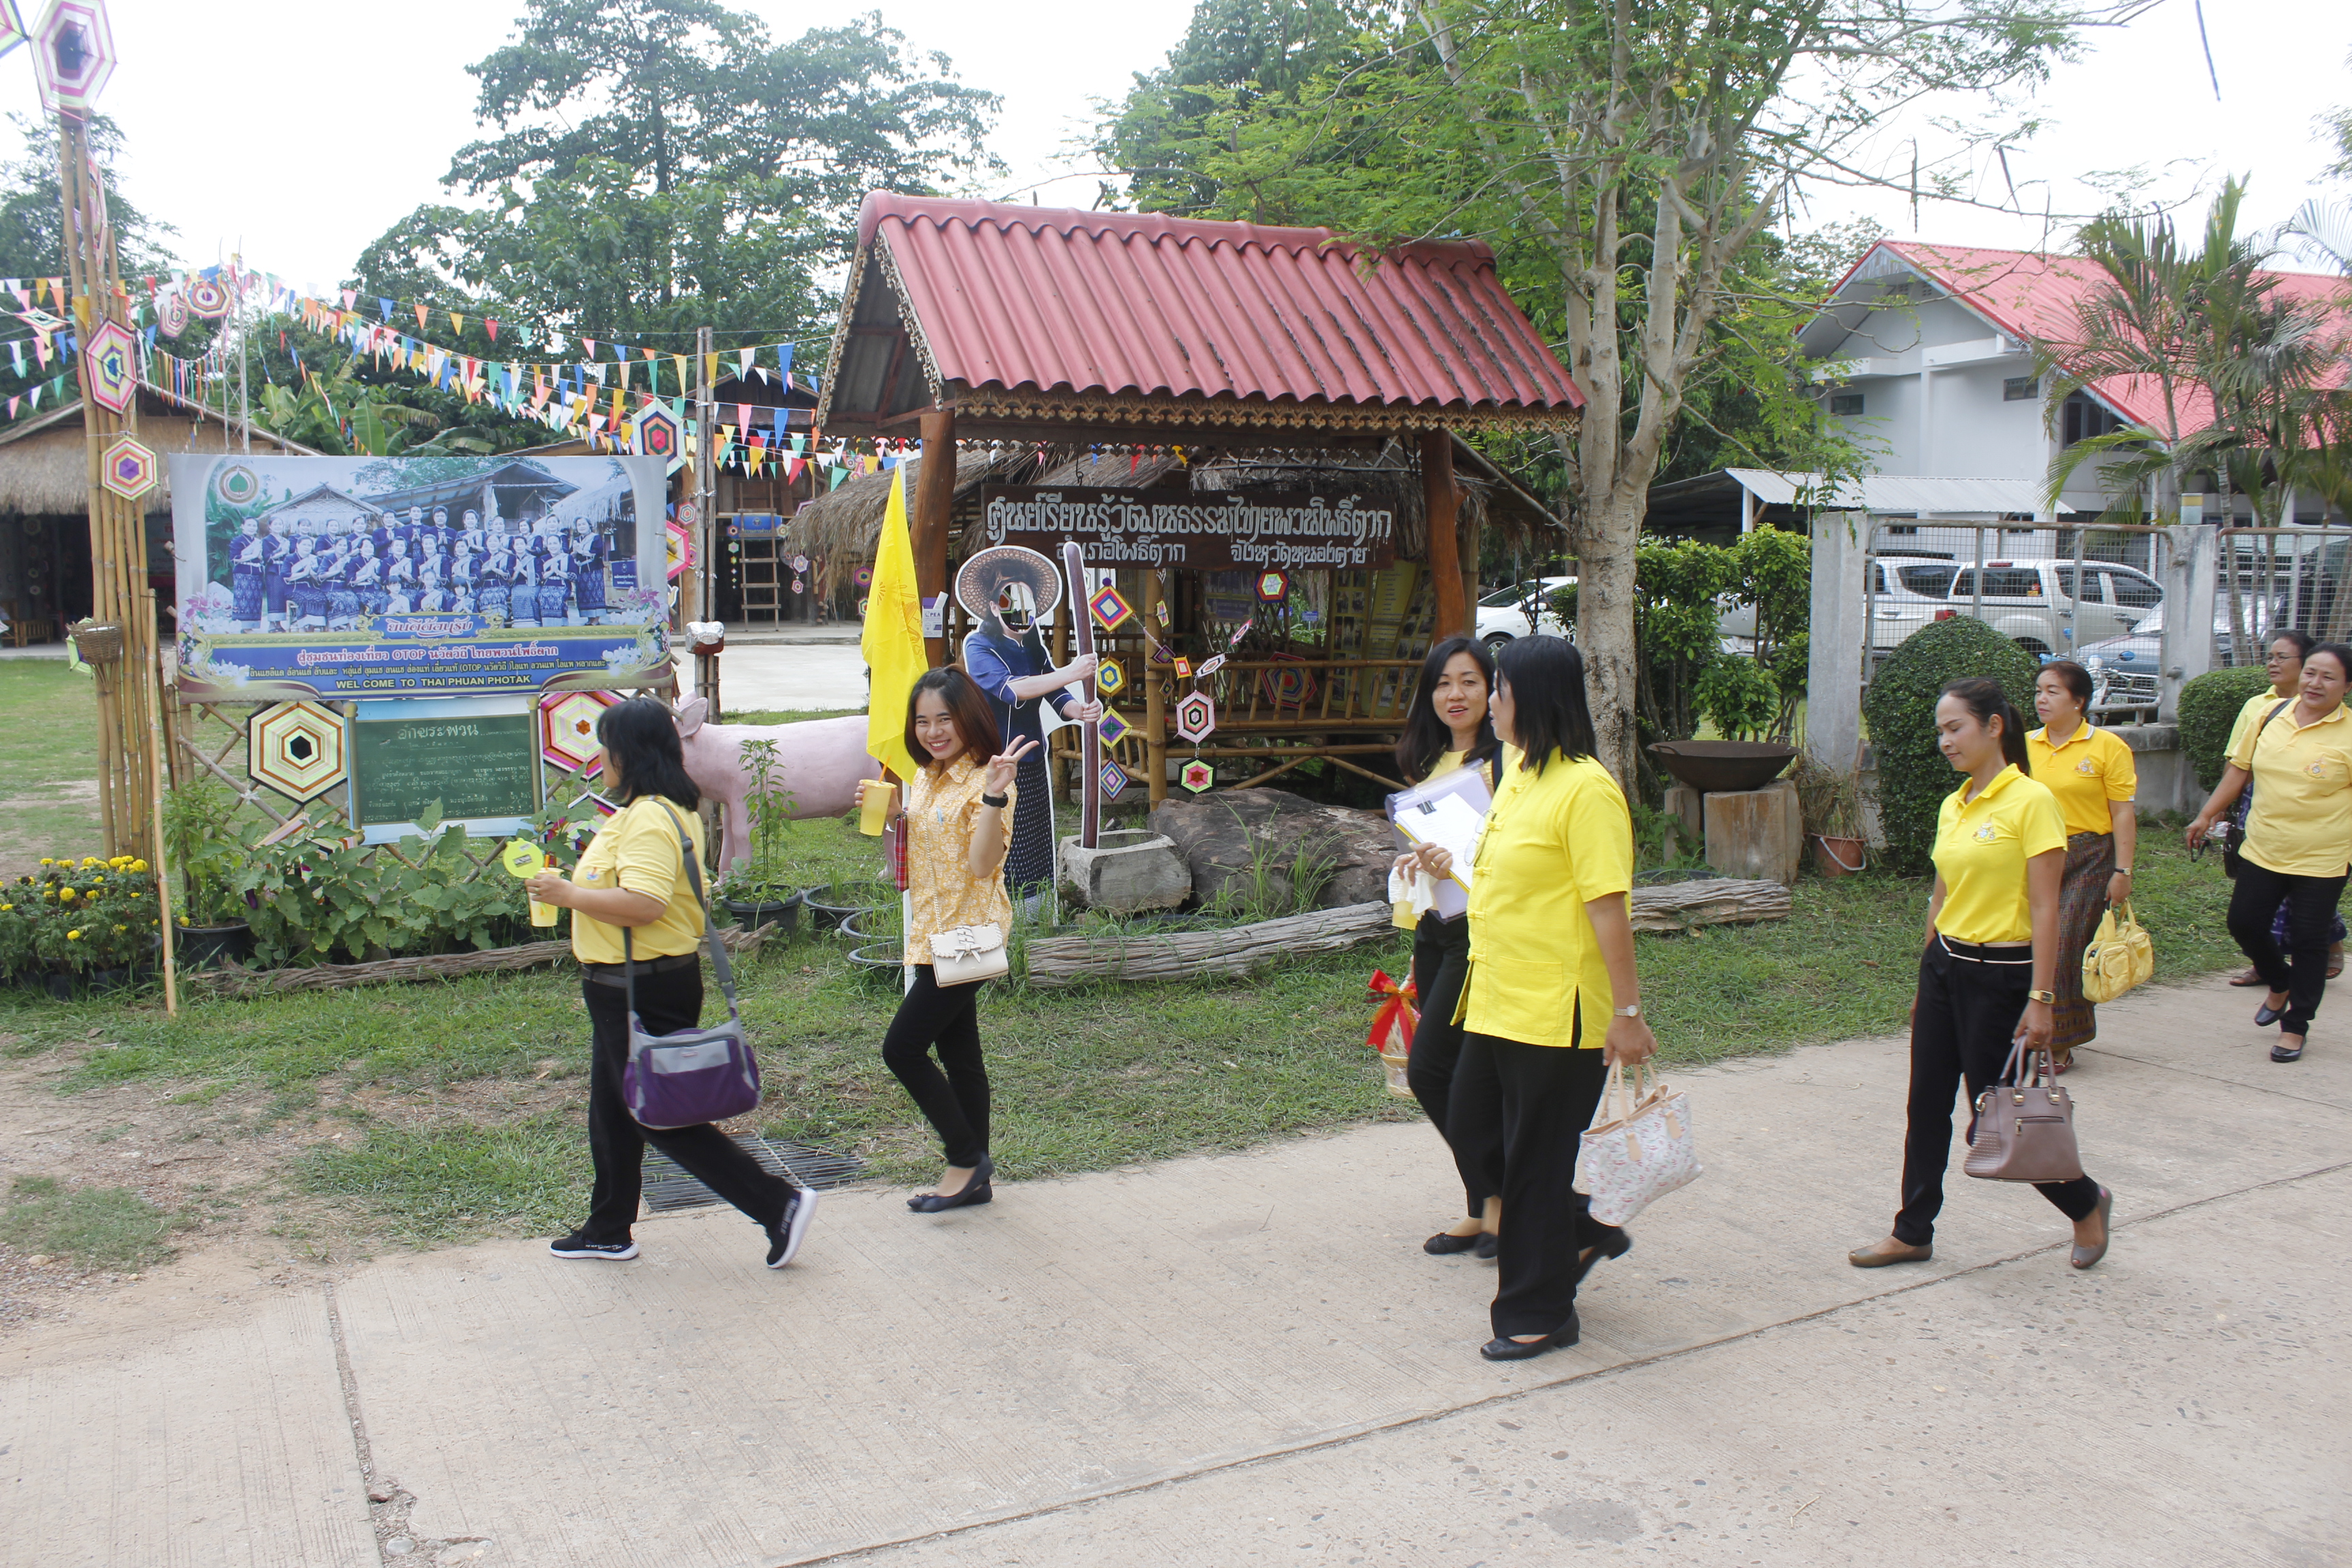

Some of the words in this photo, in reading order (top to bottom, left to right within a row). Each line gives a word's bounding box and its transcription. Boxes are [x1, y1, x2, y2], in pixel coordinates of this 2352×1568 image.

[1230, 539, 1368, 570] จังหวัดหนองคาย
[386, 615, 474, 637] ยินดีต้อนรับ
[297, 645, 389, 666] สู่ชุมชนท่องเที่ยว
[392, 649, 425, 660] OTOP
[336, 681, 360, 689] WEL
[363, 679, 395, 688] COME
[400, 679, 416, 687] TO
[421, 678, 445, 687] THAI
[448, 676, 485, 686] PHUAN
[487, 674, 531, 685] PHOTAK
